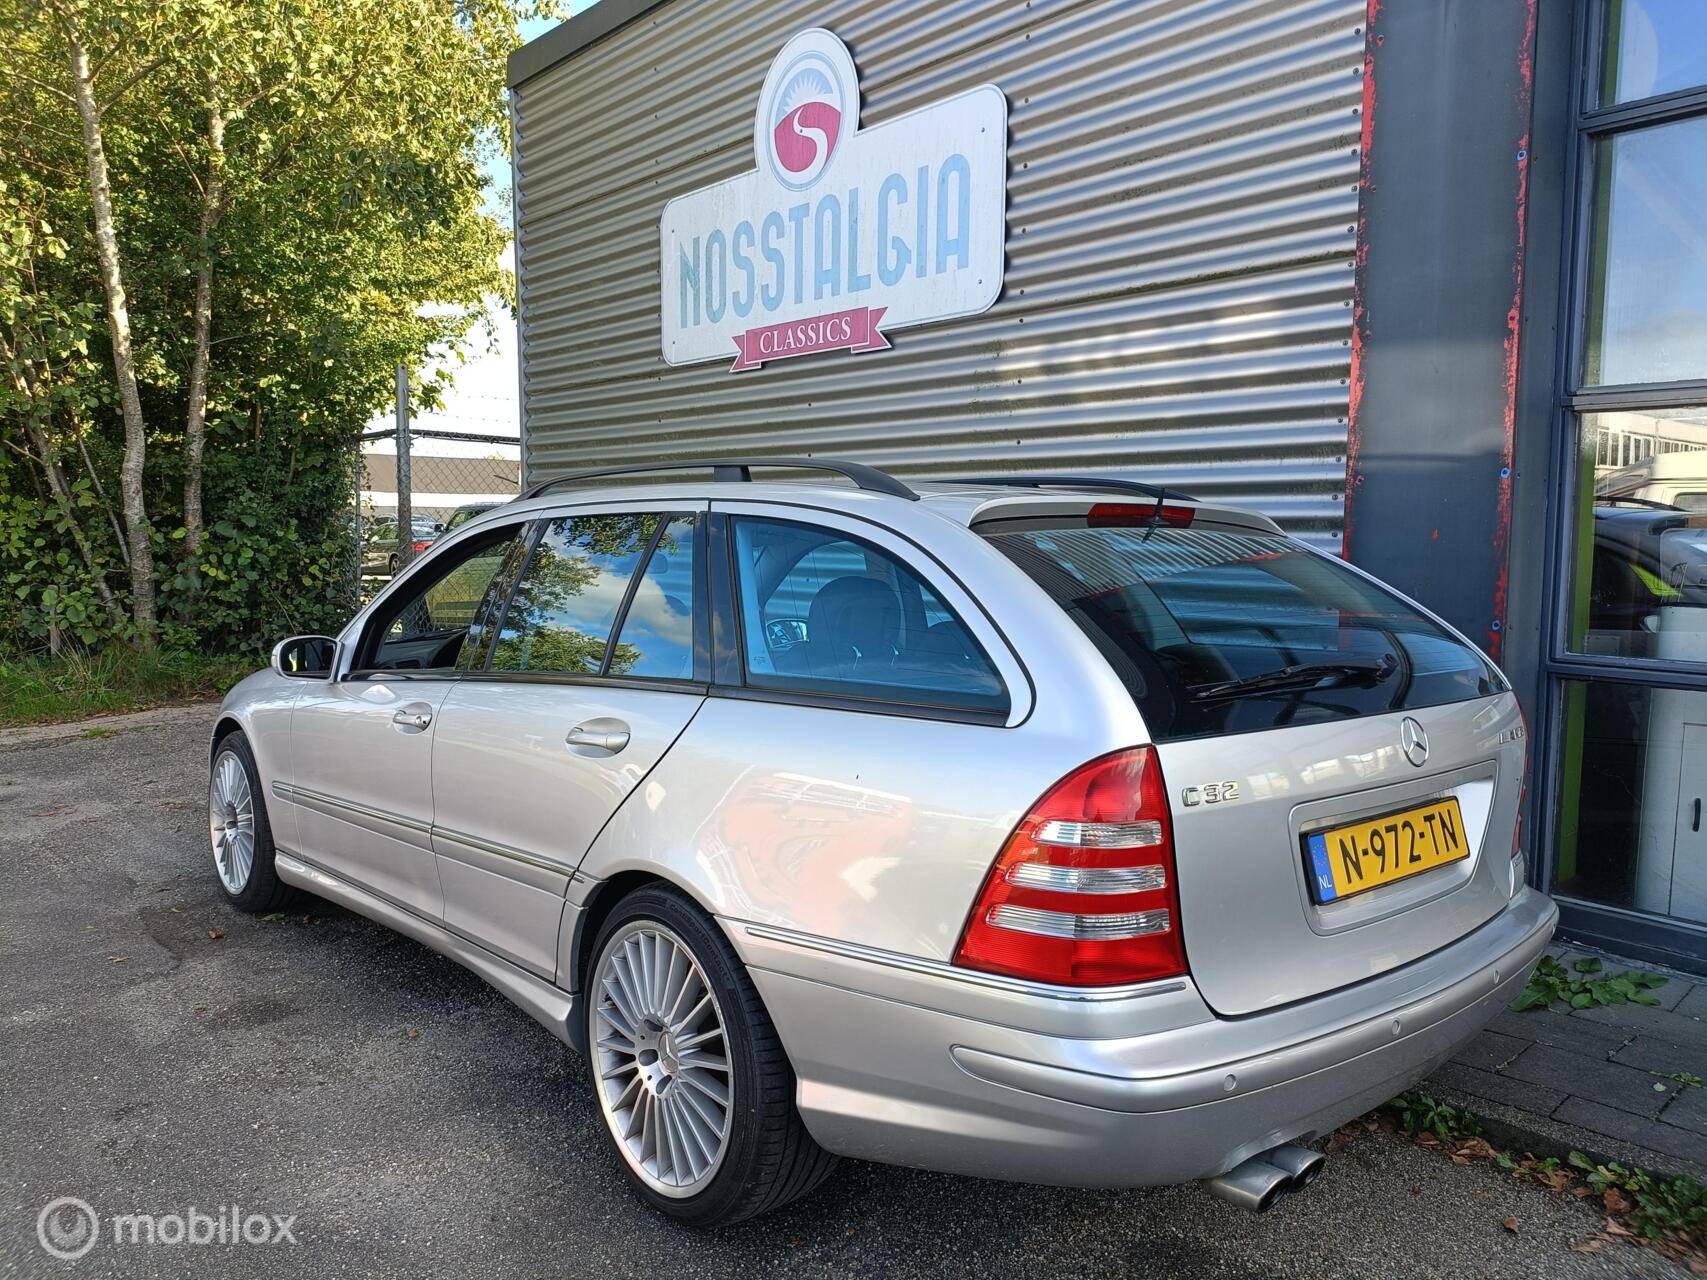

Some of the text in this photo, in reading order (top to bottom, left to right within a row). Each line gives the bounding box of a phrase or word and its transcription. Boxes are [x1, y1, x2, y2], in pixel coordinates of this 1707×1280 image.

[680, 153, 971, 329] NOSSTALGIA
[759, 317, 851, 353] CLASSICS
[1339, 809, 1459, 884] N-972-TN
[1318, 875, 1333, 889] NL
